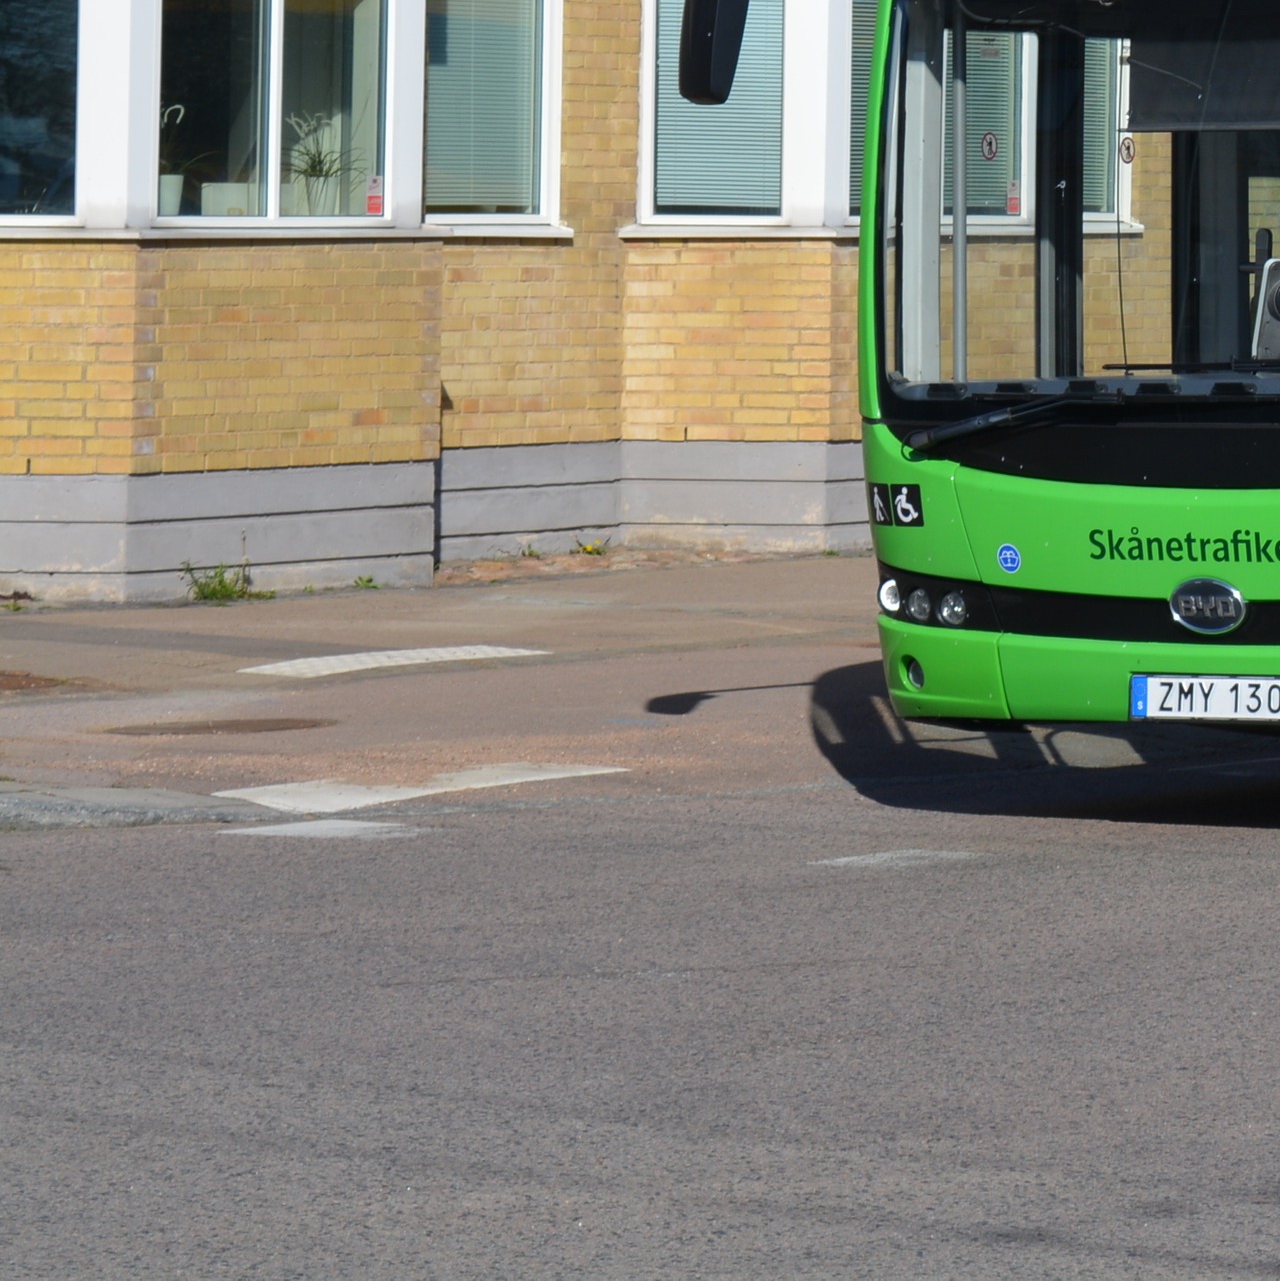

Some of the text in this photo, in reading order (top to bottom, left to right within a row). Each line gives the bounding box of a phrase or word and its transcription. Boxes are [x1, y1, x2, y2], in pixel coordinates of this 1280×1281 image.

[1177, 595, 1236, 618] BYD
[1136, 700, 1144, 710] S
[1158, 681, 1215, 713] ZMY
